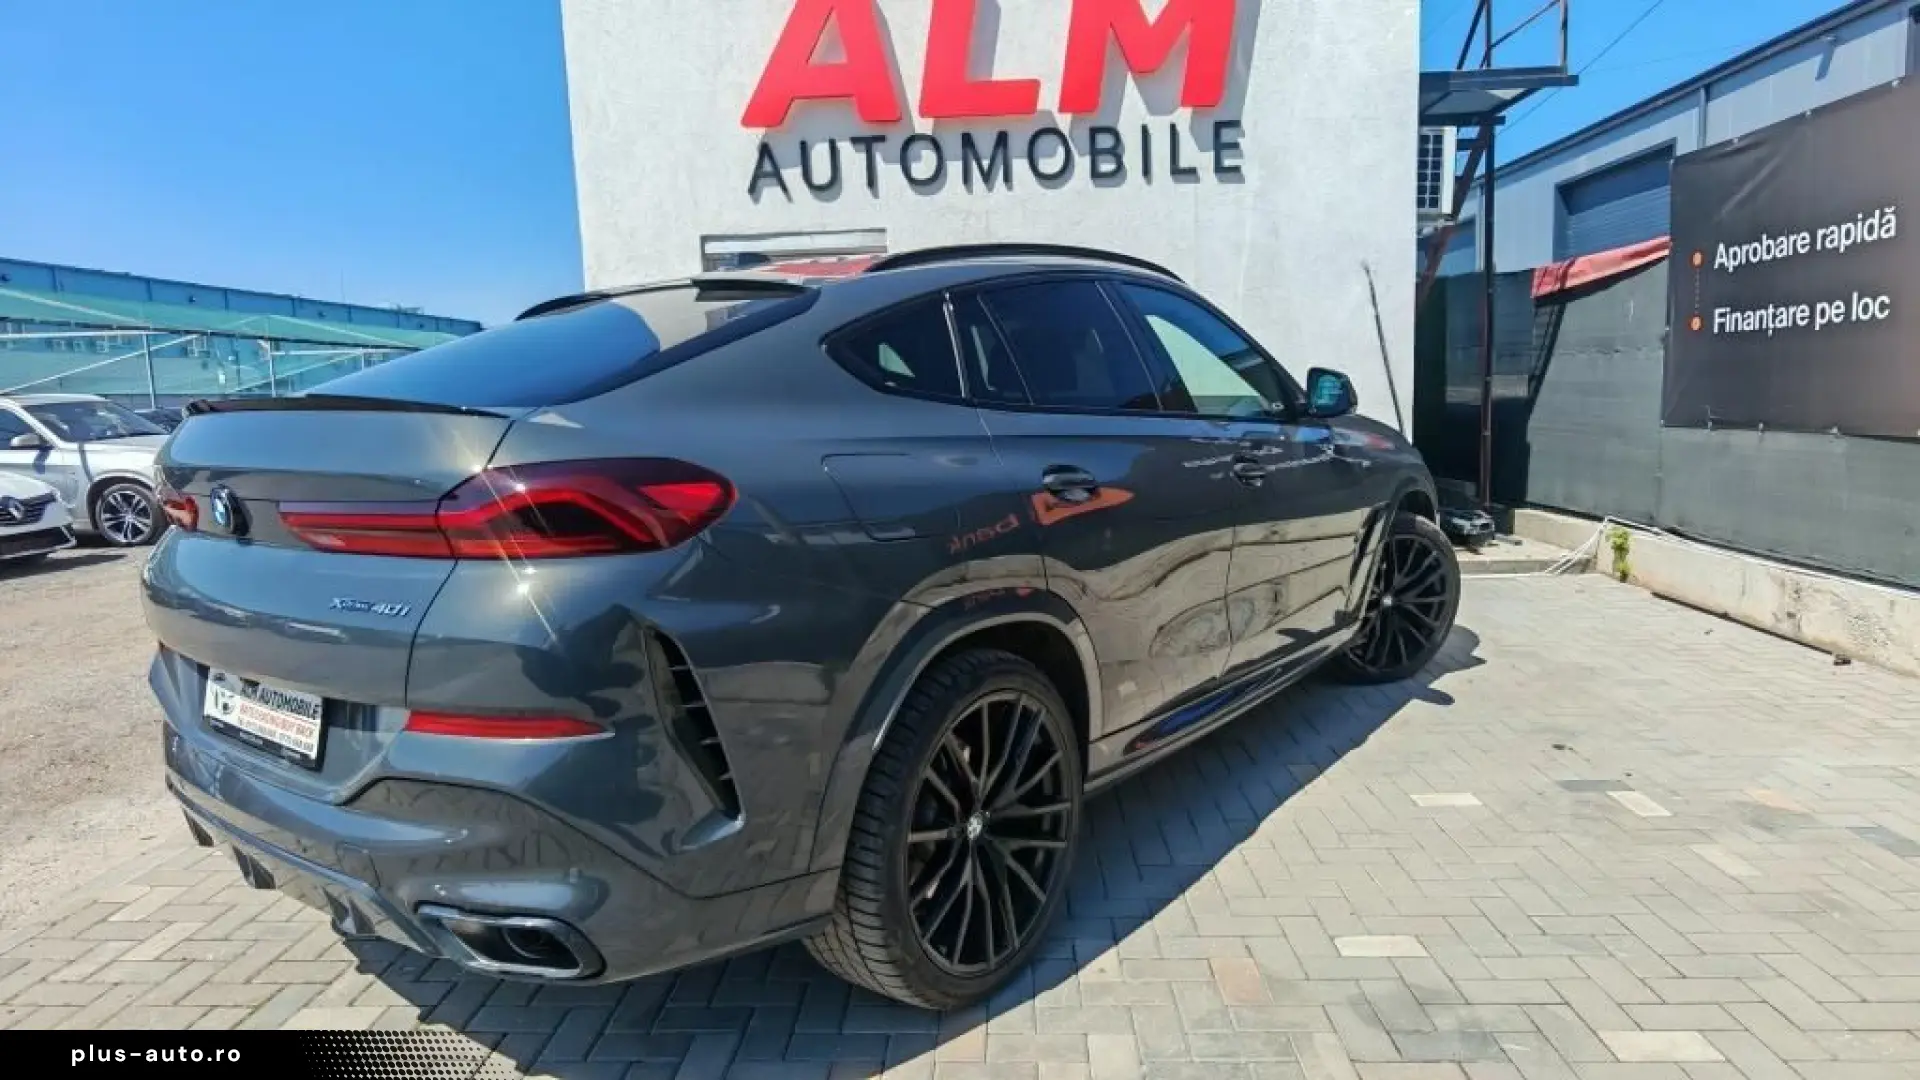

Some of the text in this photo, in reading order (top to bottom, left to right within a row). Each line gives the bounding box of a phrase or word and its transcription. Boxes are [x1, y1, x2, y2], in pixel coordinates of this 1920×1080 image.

[741, 0, 1236, 127] ALM
[748, 120, 1245, 198] AUTOMOBILE
[1714, 206, 1897, 273] Aprobare rapidă
[1713, 291, 1891, 338] Finanțare pe loc
